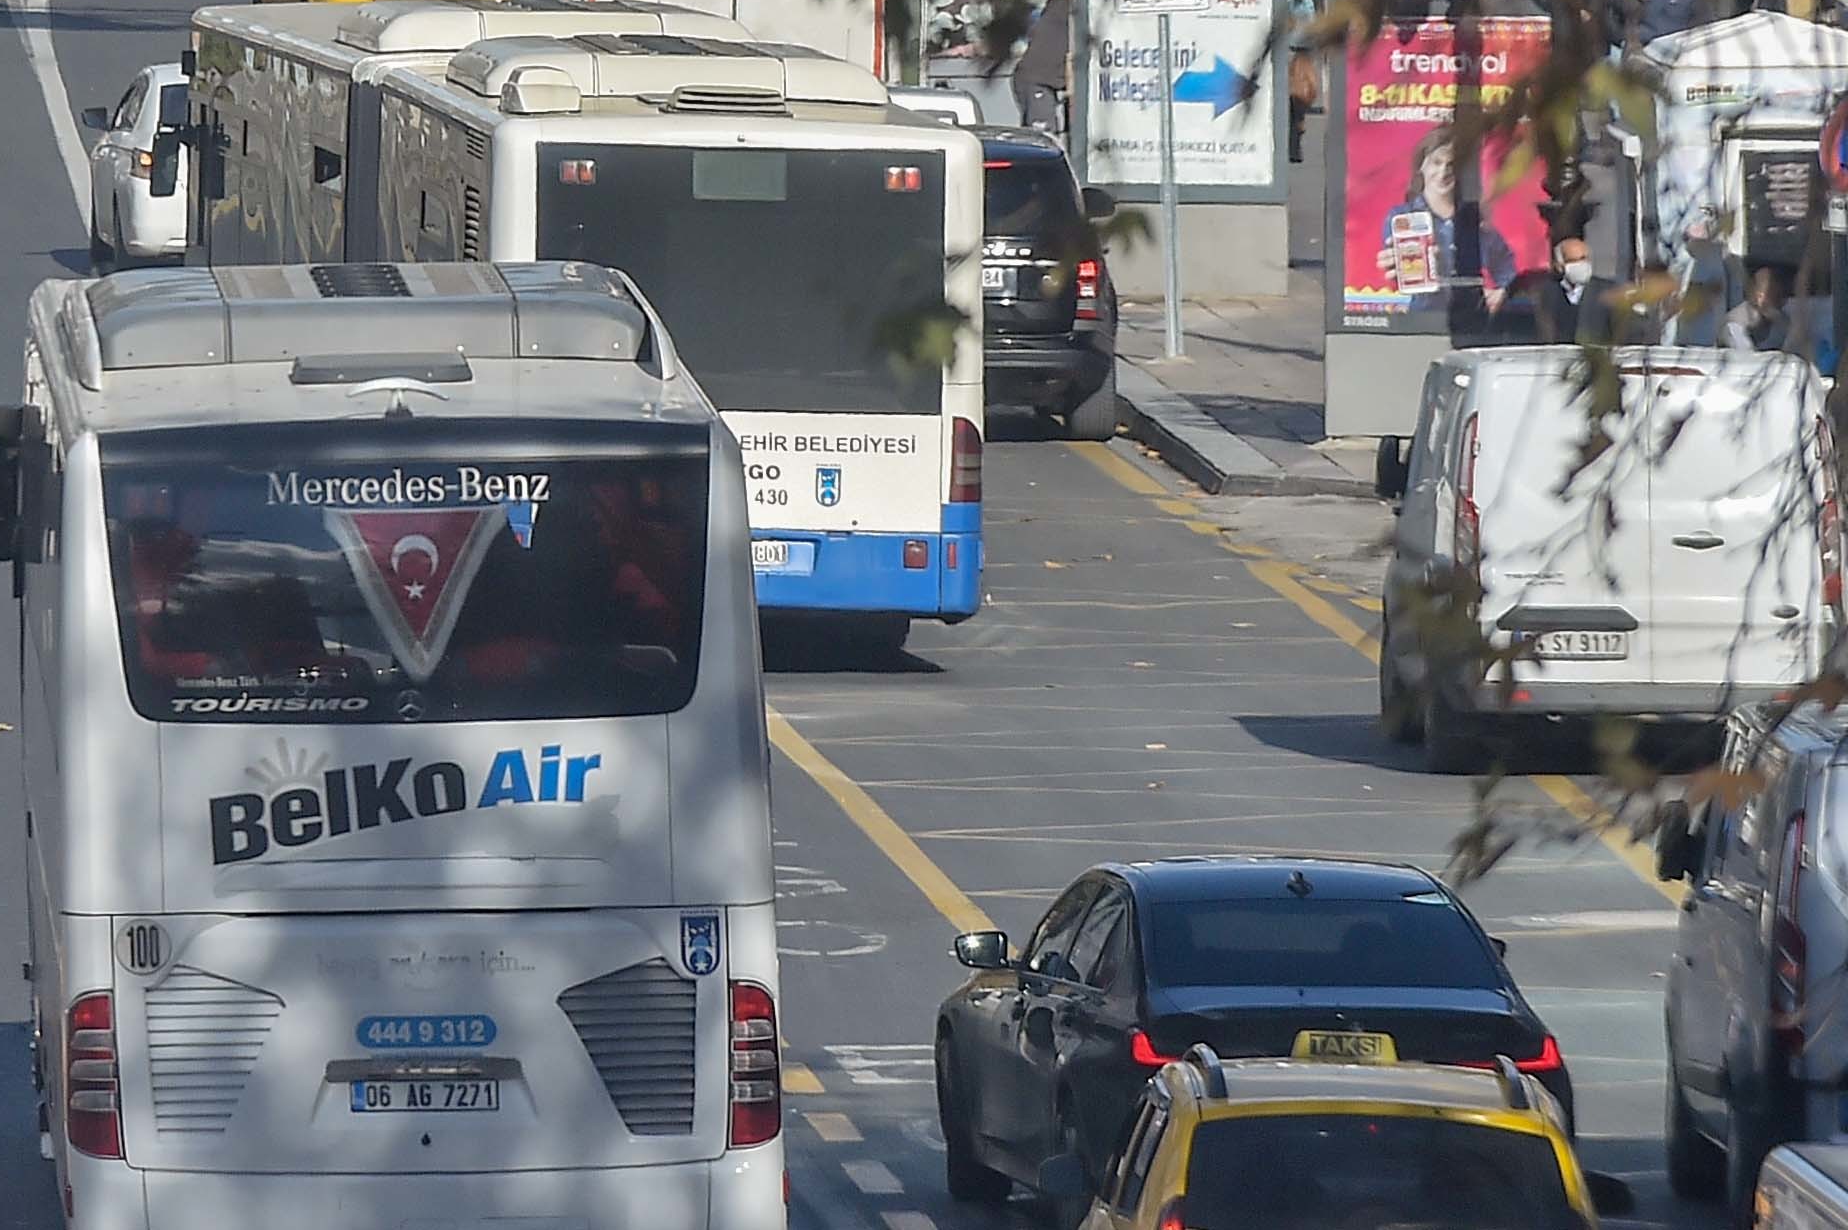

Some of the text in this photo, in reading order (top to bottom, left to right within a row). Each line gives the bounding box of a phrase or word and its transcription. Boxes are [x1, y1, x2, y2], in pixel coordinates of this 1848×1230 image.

[1102, 39, 1196, 70] Geleceini
[1099, 75, 1161, 111] Netleşti
[794, 434, 917, 453] BELEDİYESİ
[265, 467, 551, 506] Mercedes-Benz
[1552, 633, 1574, 652] SY
[1579, 633, 1621, 652] 9117
[170, 696, 370, 713] TOURISMO
[477, 744, 602, 808] Air
[126, 925, 161, 969] 100
[368, 1020, 486, 1043] 444 9 312
[365, 1083, 493, 1108] 06 AG 7271
